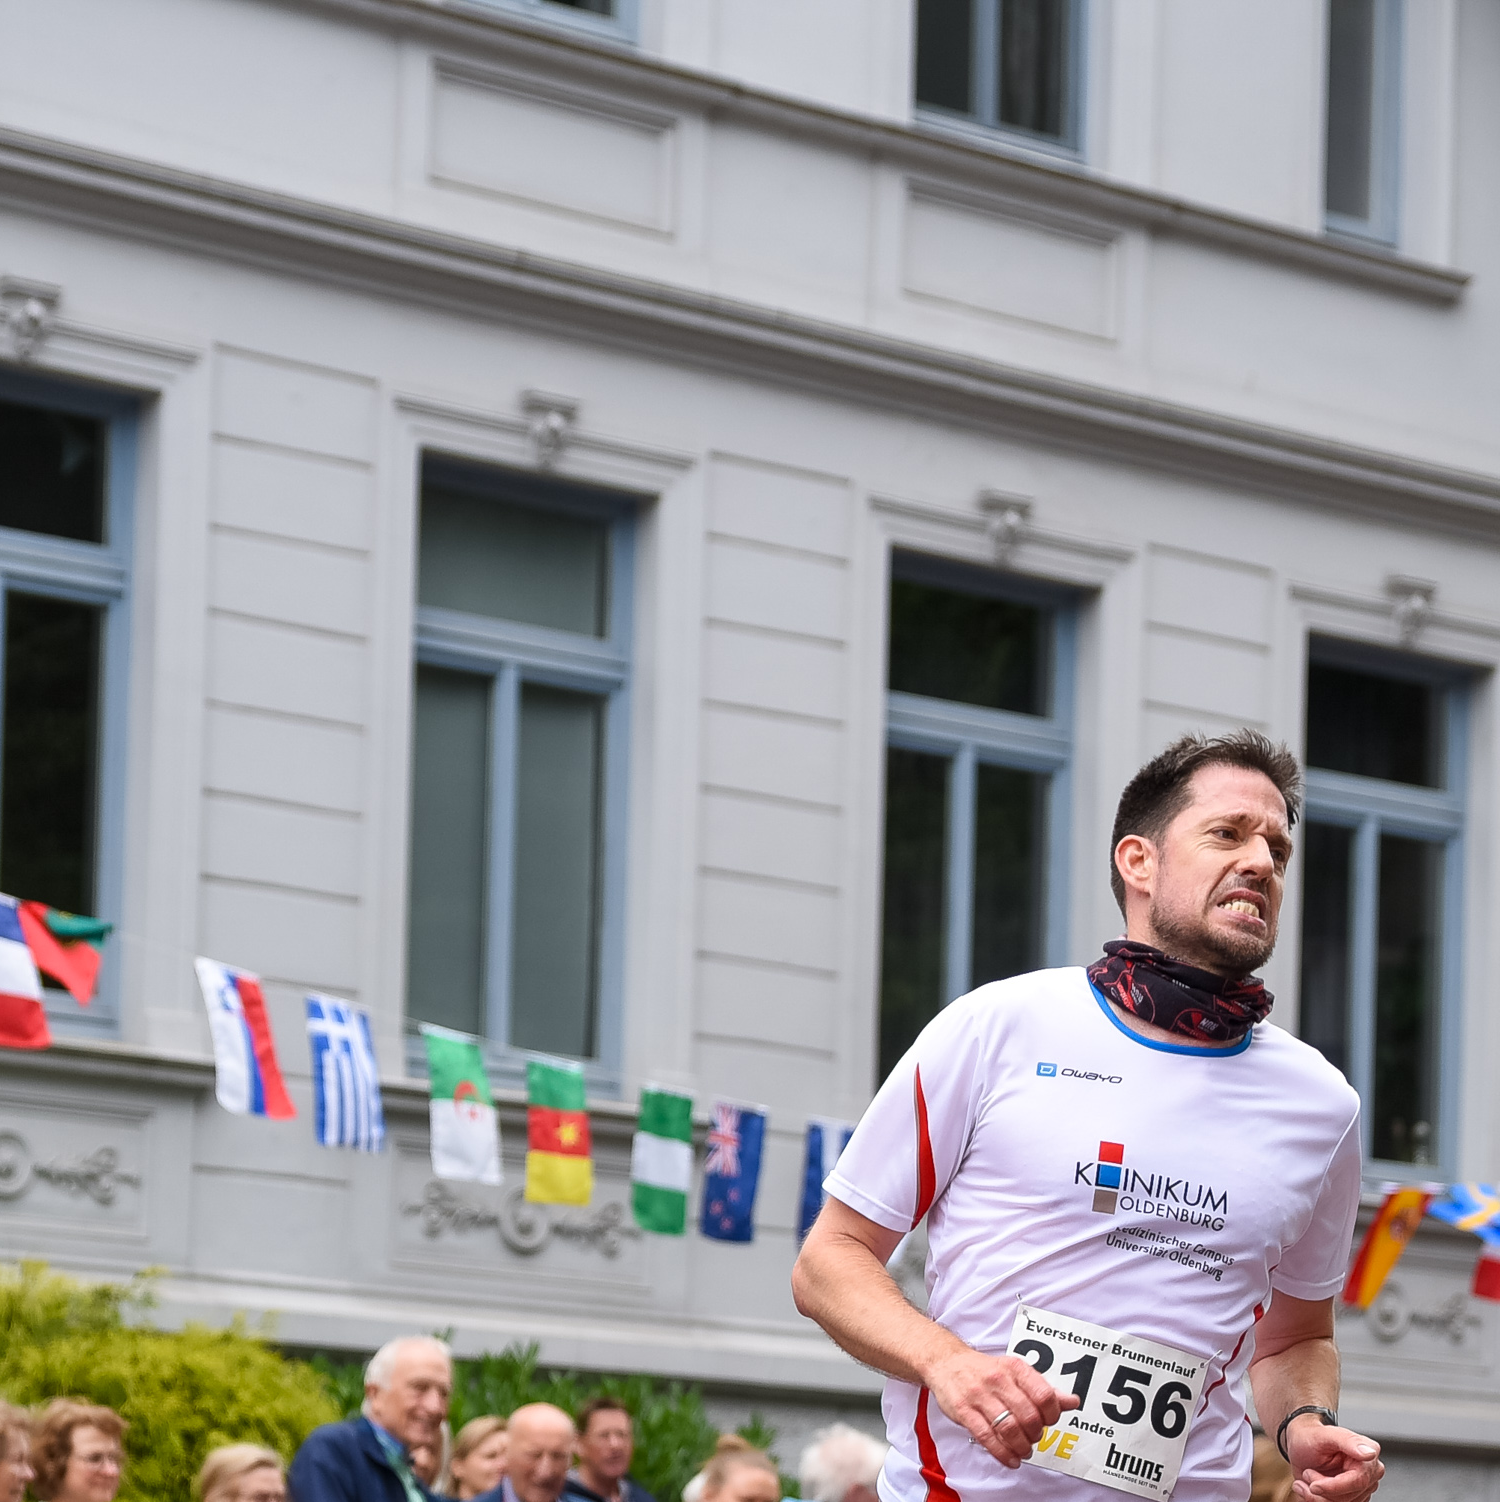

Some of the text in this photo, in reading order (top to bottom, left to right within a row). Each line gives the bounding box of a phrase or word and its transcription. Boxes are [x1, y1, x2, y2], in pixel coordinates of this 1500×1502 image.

[1119, 1195, 1226, 1232] OLDENBURG
[1105, 1233, 1224, 1282] Universität Oldenburg
[1115, 1226, 1236, 1267] edizinischer Campus
[1025, 1319, 1198, 1379] Everstener Brunnenlauf
[1068, 1415, 1116, 1439] André
[1104, 1442, 1165, 1483] bruns
